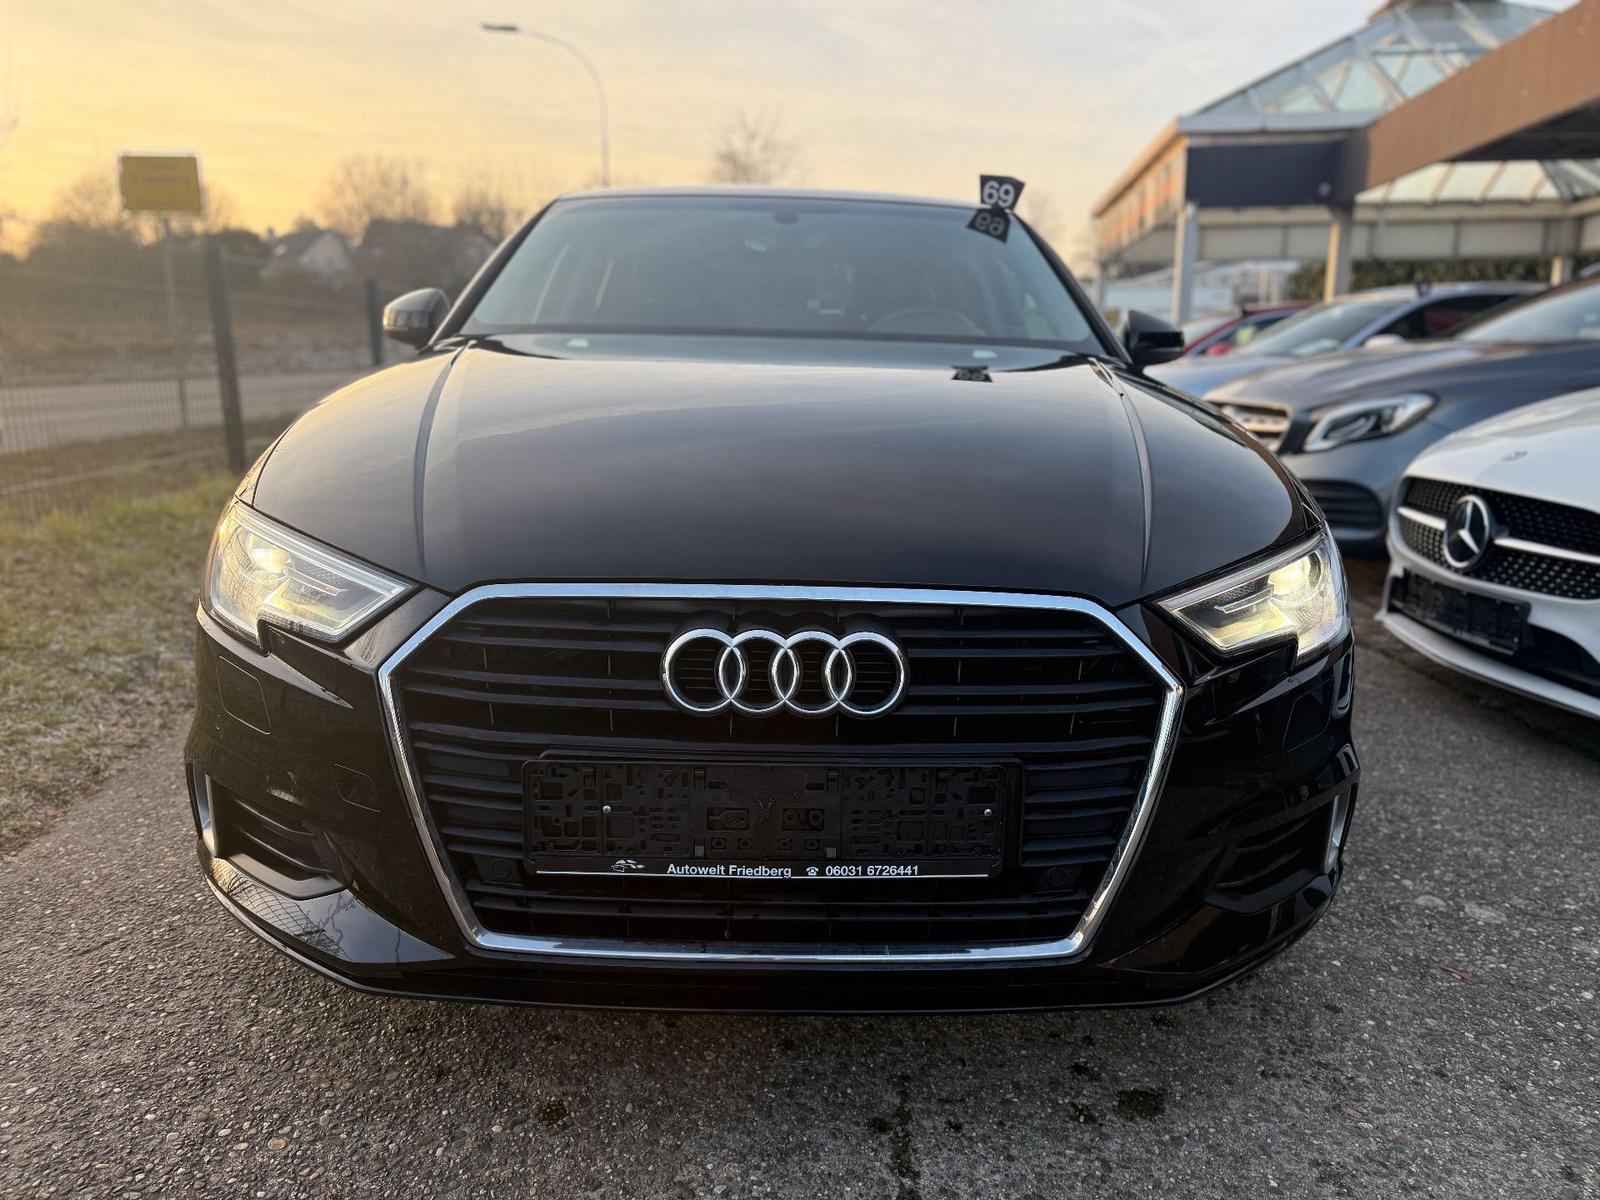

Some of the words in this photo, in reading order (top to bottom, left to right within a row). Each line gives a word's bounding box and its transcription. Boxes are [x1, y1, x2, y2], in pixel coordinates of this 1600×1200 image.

[982, 180, 1016, 208] 69
[666, 863, 726, 875] Autowelt
[728, 864, 792, 879] Friedberg
[825, 865, 862, 876] 06031
[866, 864, 919, 876] 6726441
